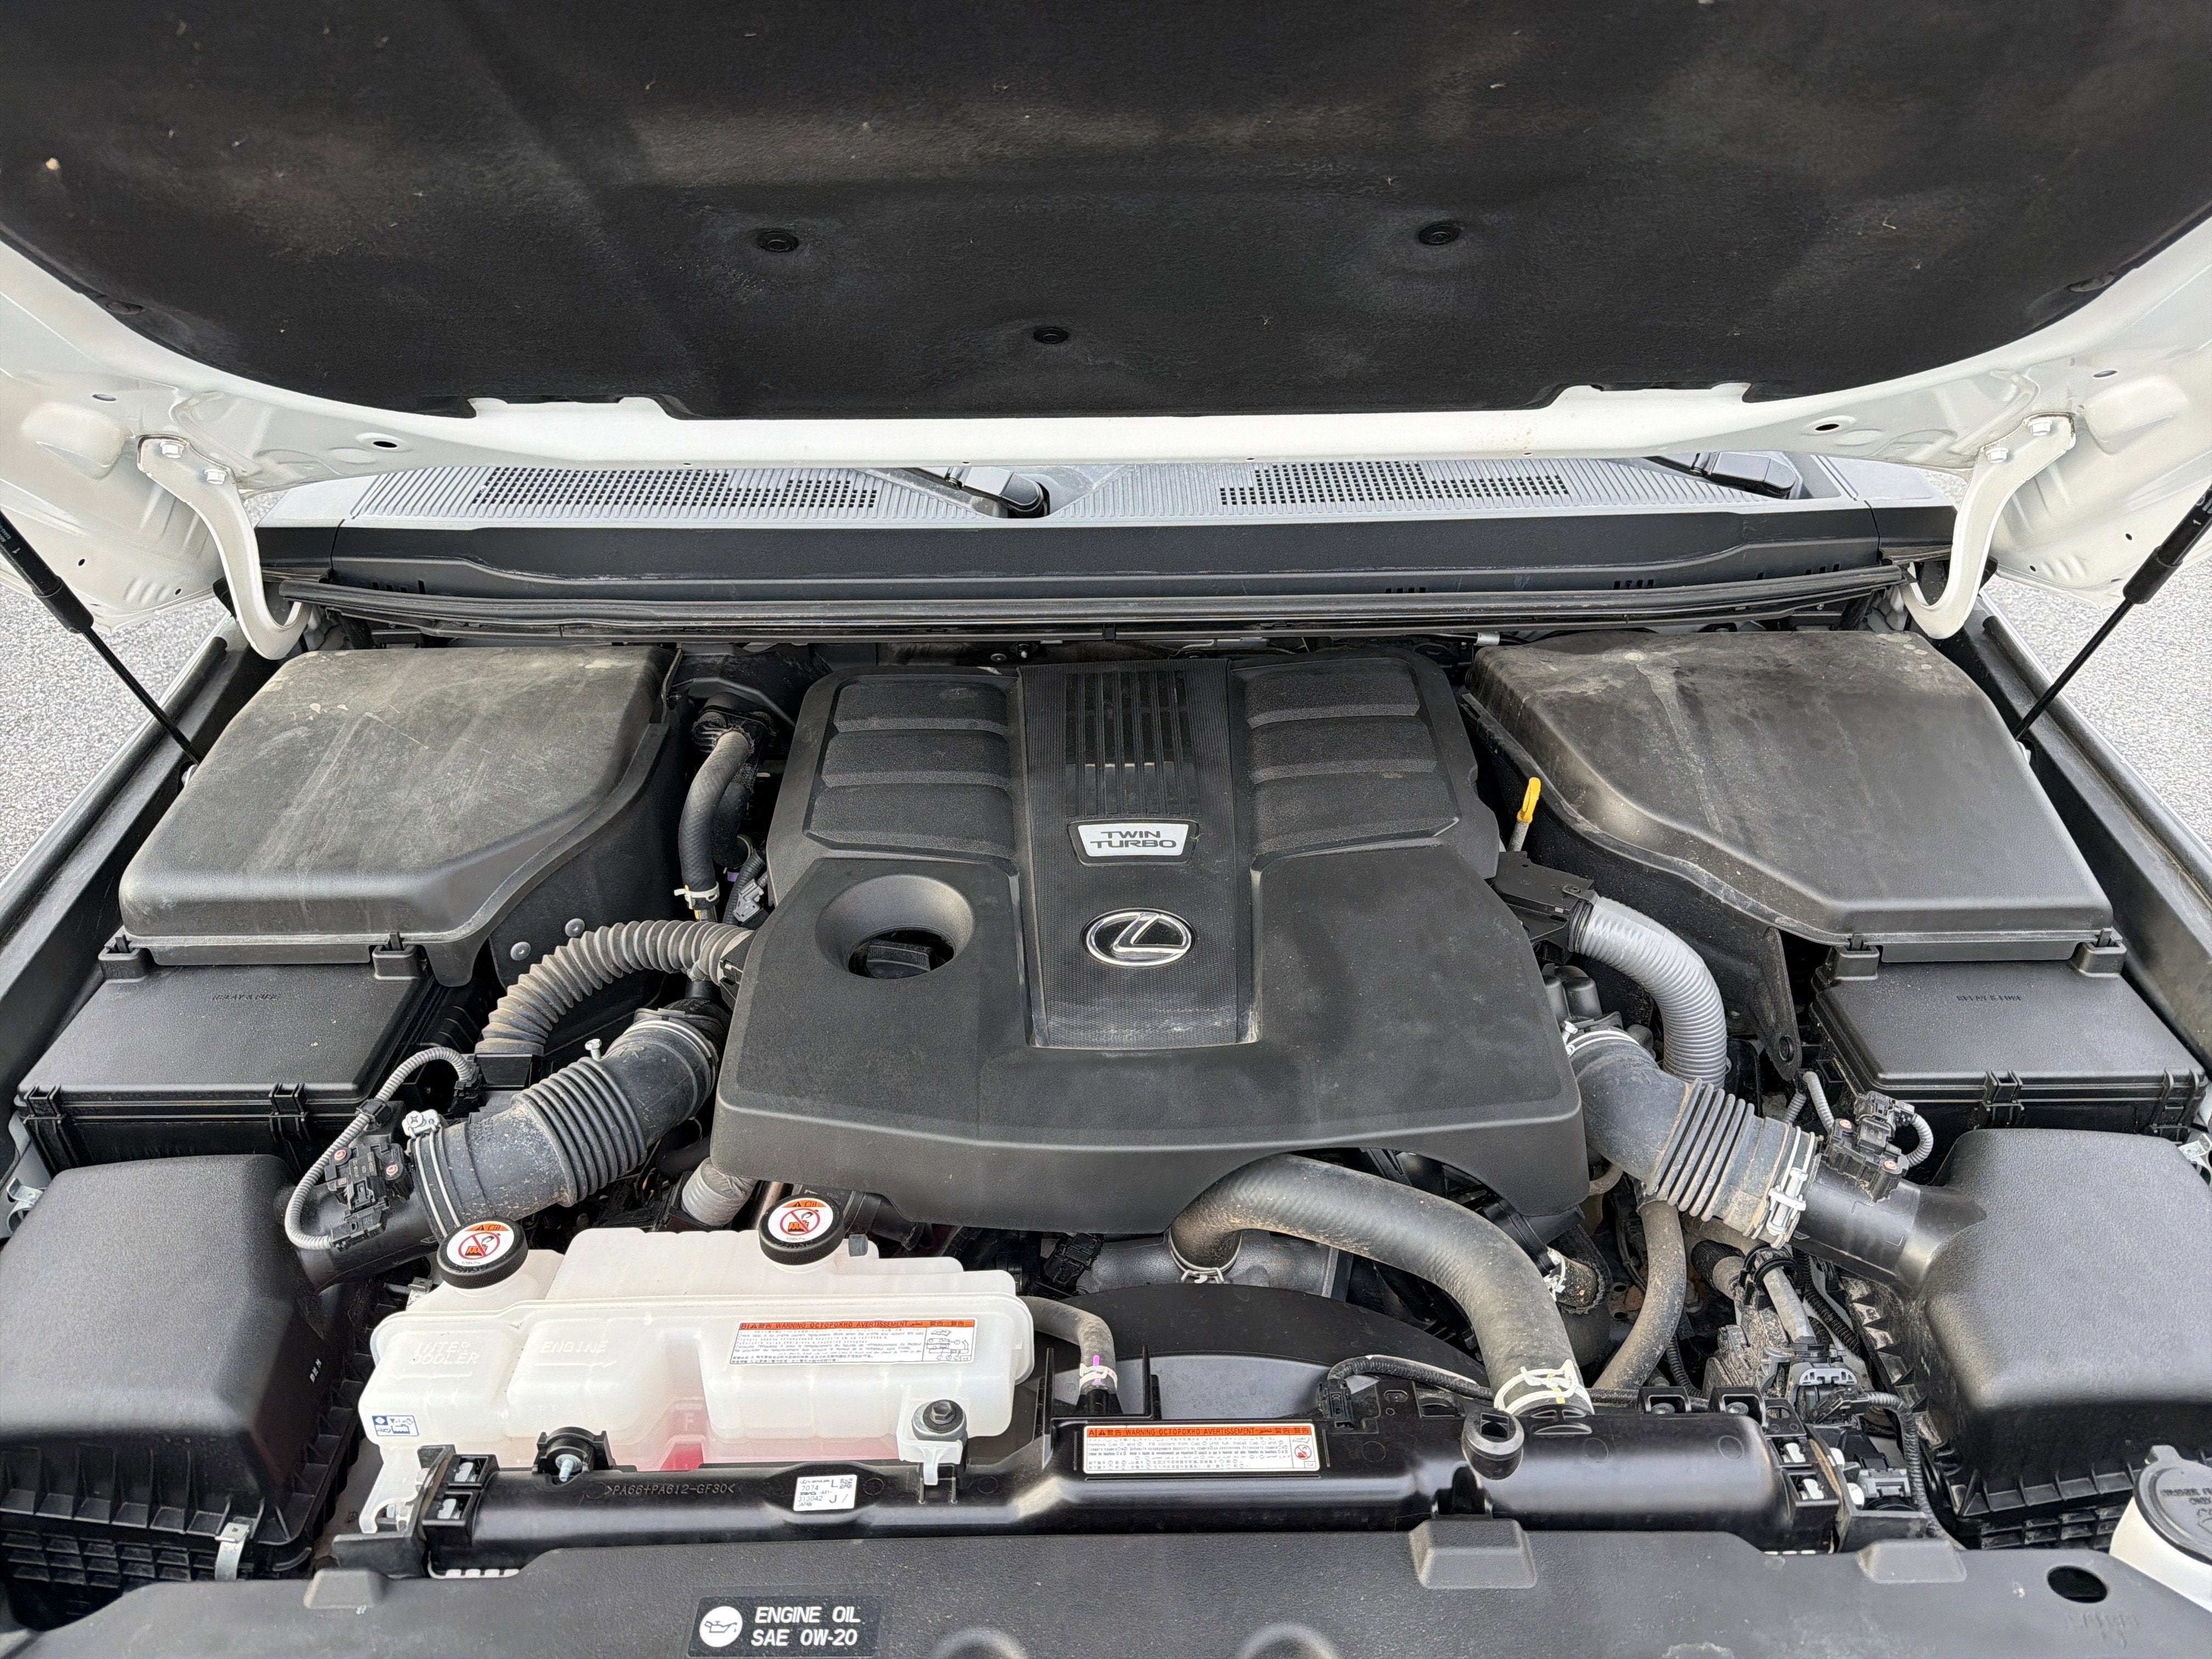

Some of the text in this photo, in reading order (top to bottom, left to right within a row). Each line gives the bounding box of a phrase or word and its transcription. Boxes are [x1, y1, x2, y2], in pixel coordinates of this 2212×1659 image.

[1101, 831, 1161, 839] TWIN
[1090, 839, 1177, 849] TURBO
[539, 1340, 609, 1353] ENGINE
[755, 1606, 861, 1623] ENGINE OIL
[751, 1629, 857, 1646] SAE 0W-20
